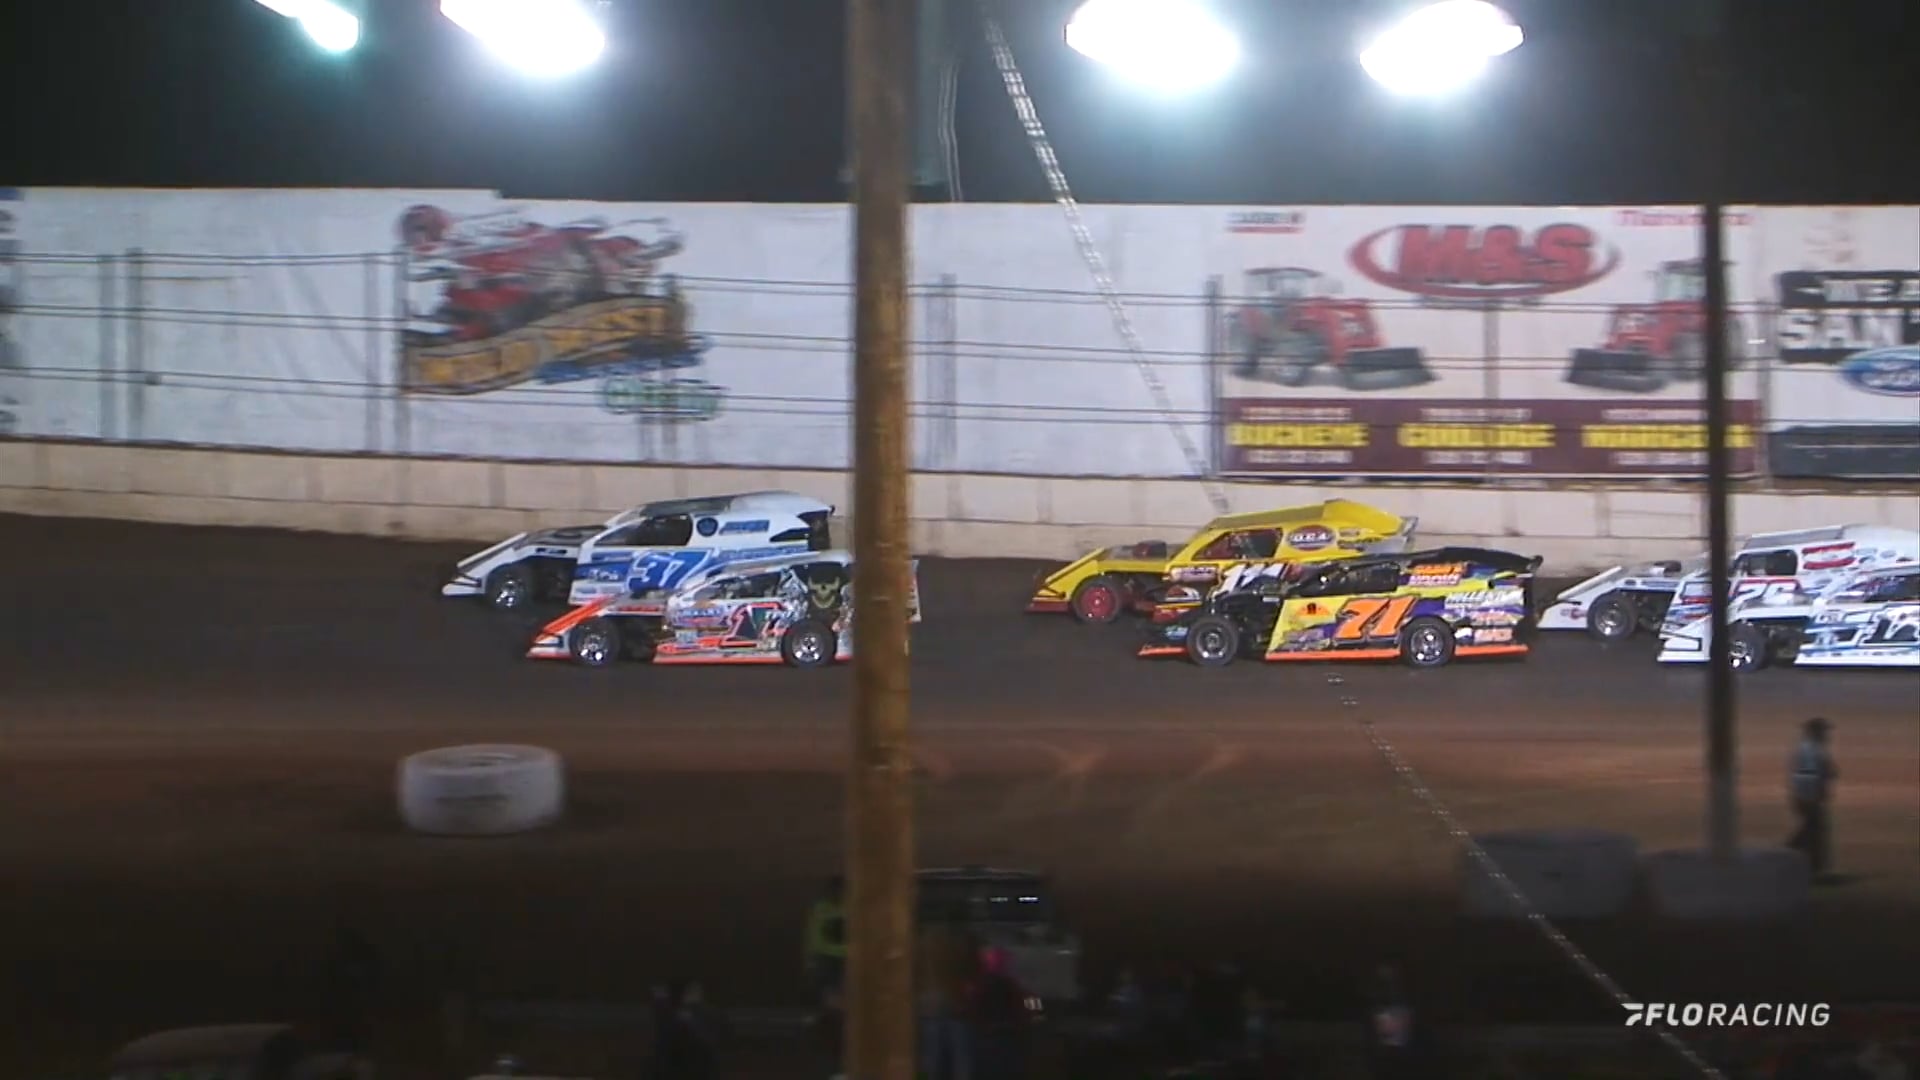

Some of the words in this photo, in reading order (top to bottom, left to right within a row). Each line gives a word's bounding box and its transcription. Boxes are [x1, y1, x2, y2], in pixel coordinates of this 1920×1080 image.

[1396, 222, 1596, 285] M&S
[627, 549, 710, 592] 37
[1334, 597, 1416, 641] 71
